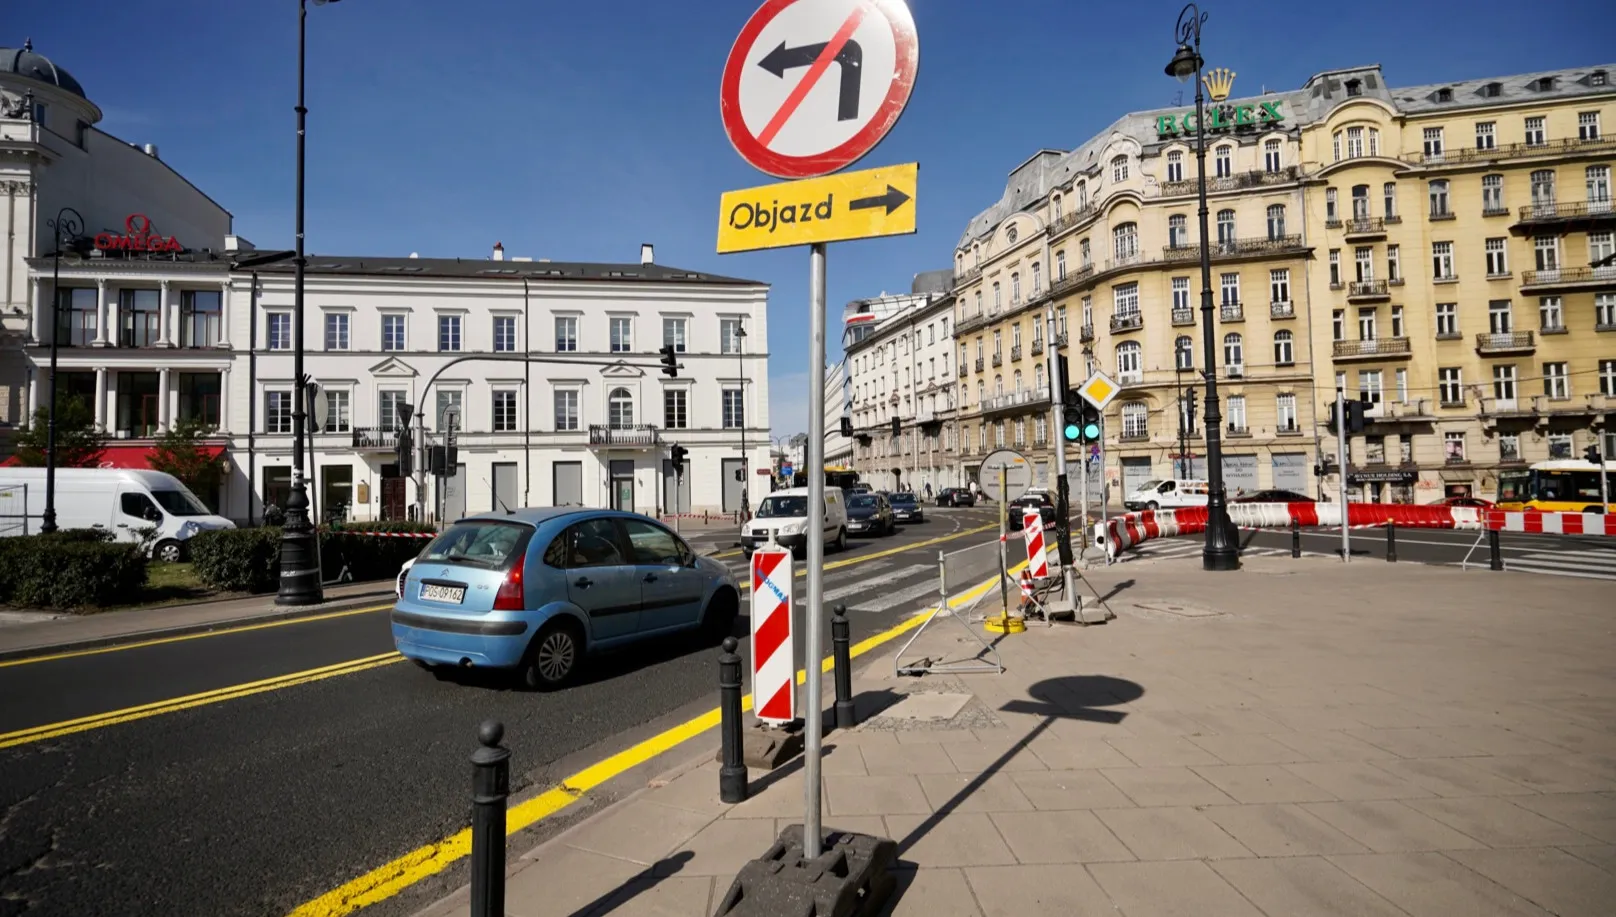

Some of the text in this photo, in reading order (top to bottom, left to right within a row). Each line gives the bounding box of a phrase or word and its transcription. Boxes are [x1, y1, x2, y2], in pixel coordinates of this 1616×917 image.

[1157, 100, 1285, 136] ROLEX
[729, 193, 833, 233] Objazd
[95, 232, 183, 251] OMEGA
[440, 588, 462, 600] 09162
